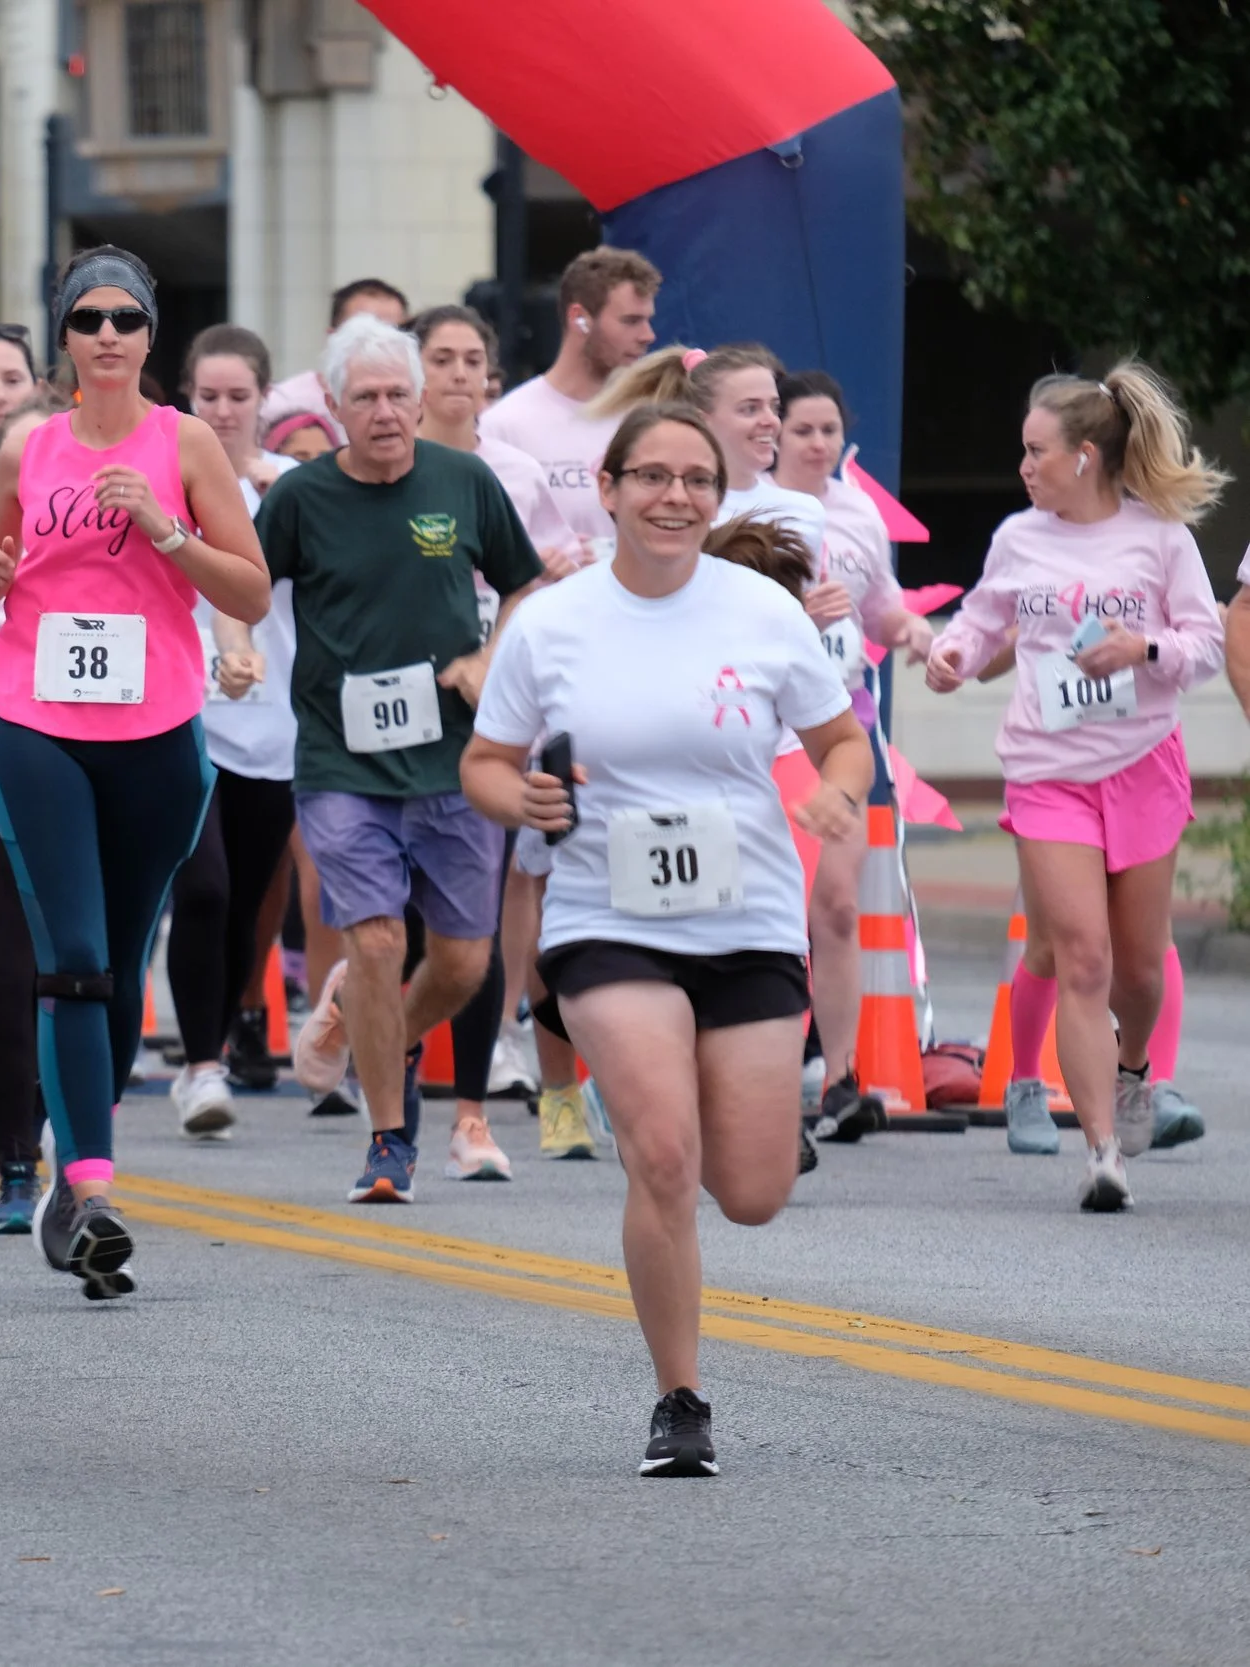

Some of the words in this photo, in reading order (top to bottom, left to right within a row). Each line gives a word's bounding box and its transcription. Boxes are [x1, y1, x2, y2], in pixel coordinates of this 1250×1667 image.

[549, 468, 591, 489] ACE
[35, 484, 135, 556] Slay
[1016, 593, 1057, 617] ACE
[1084, 590, 1146, 622] HOPE
[68, 645, 109, 680] 38
[1058, 672, 1113, 709] 100
[373, 697, 409, 731] 90
[648, 843, 699, 889] 30
